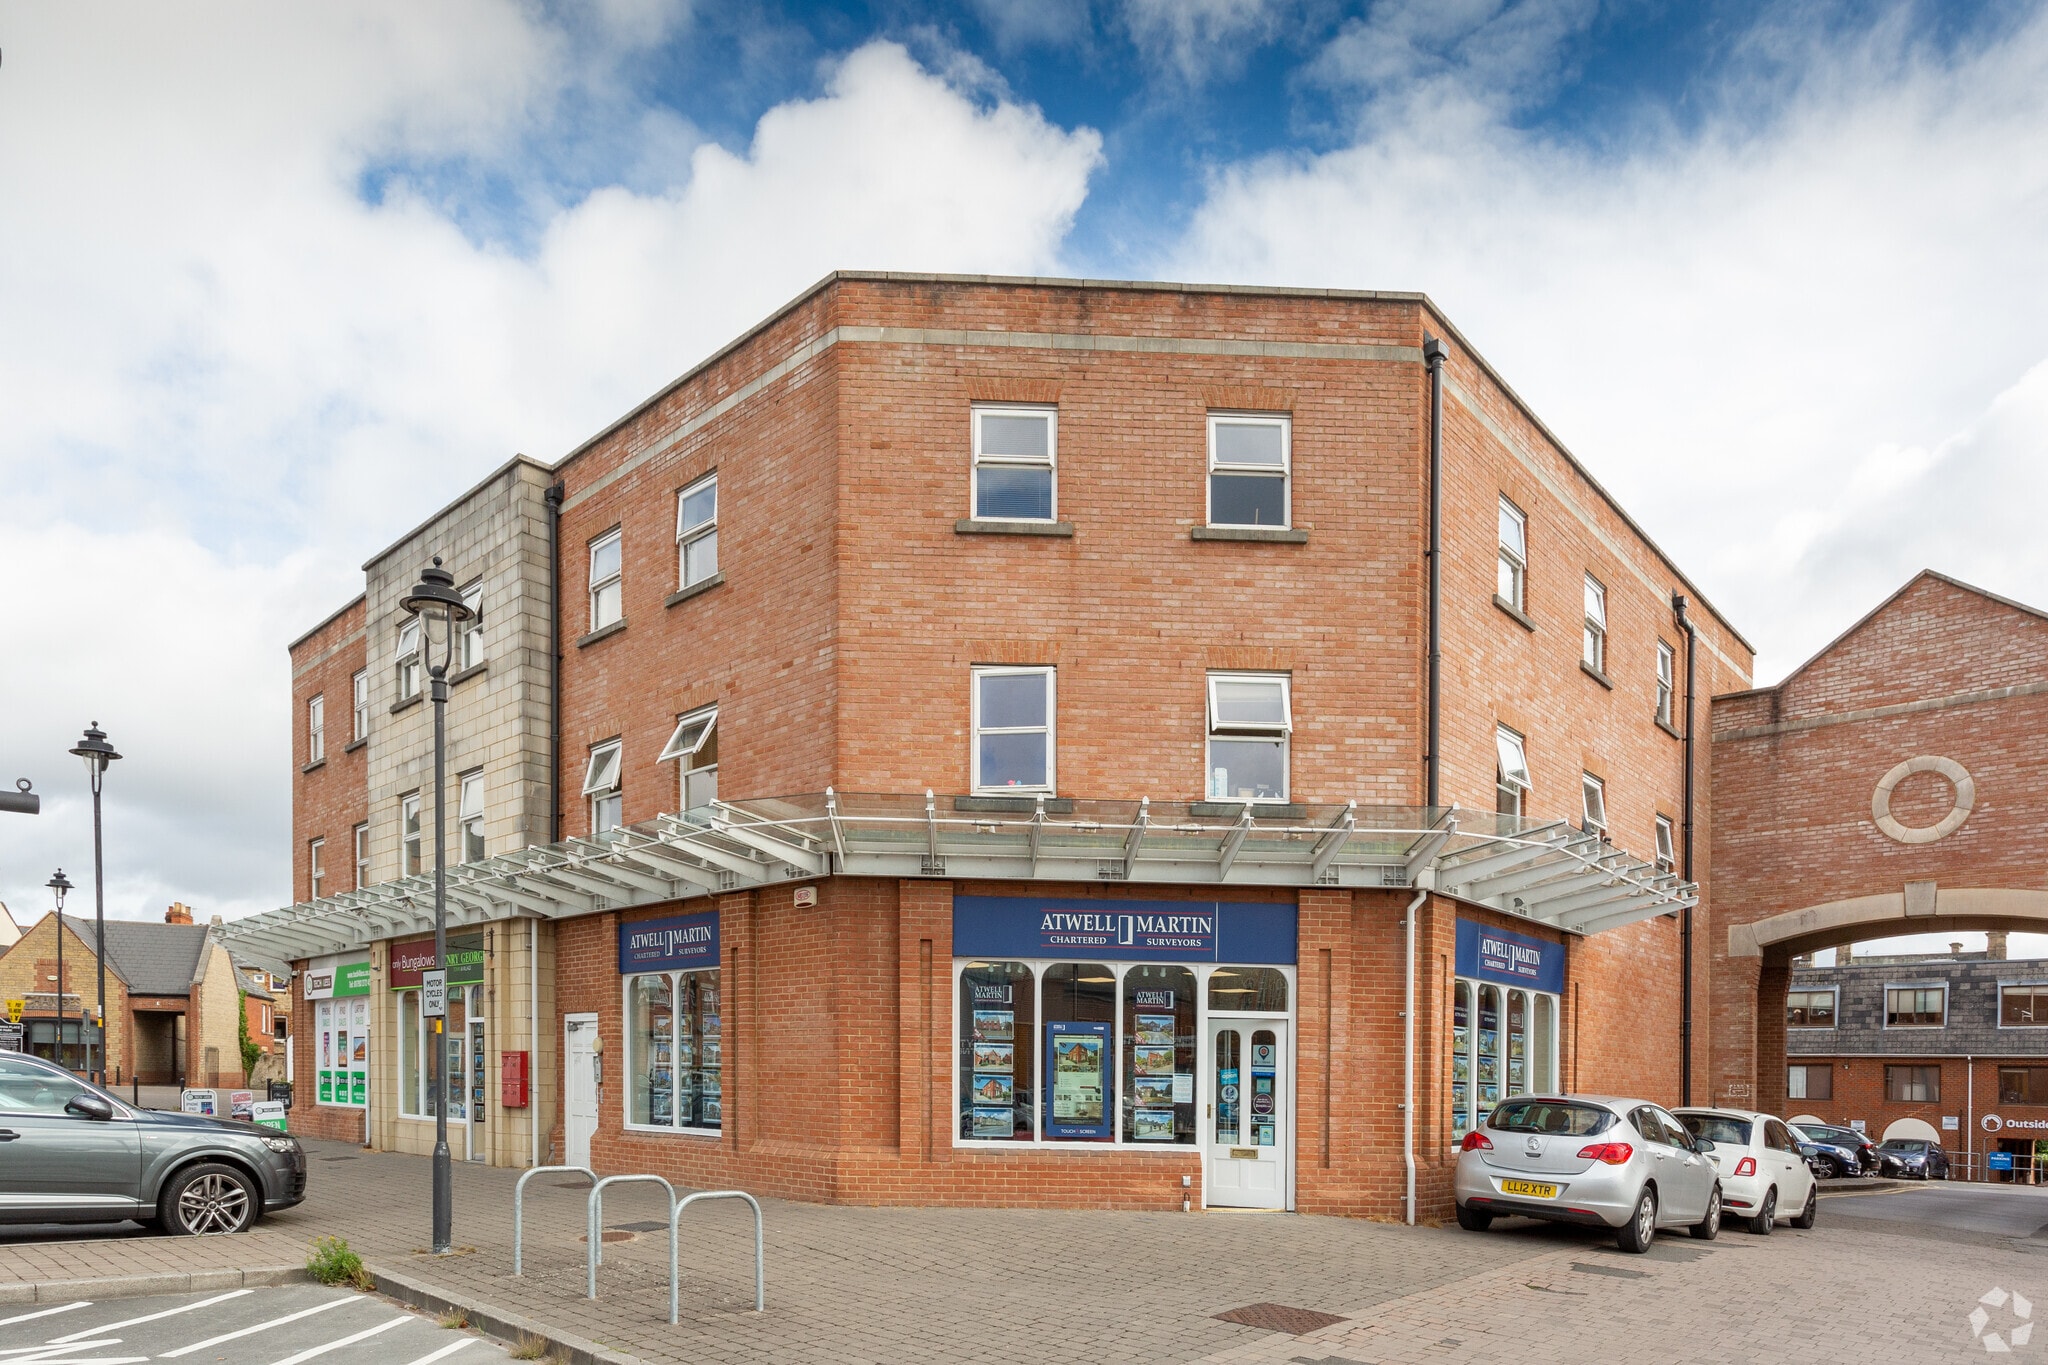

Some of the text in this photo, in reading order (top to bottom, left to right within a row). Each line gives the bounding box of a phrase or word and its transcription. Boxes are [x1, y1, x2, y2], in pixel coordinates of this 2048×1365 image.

[1040, 913, 1213, 934] ATWELL MARTIN
[630, 926, 712, 949] ATWELL MARTIN
[1050, 936, 1202, 947] CHARTERED SURVEYORS
[446, 953, 460, 965] NRY
[634, 946, 707, 960] CHARTERED SURVEYORS
[1481, 938, 1541, 966] ATWELL MARTIN
[392, 953, 435, 971] only Bungalows
[426, 979, 442, 988] MOTOR
[426, 990, 442, 998] CYCLES
[428, 1000, 440, 1008] ONLY
[1507, 1181, 1551, 1196] LL12 XTR
